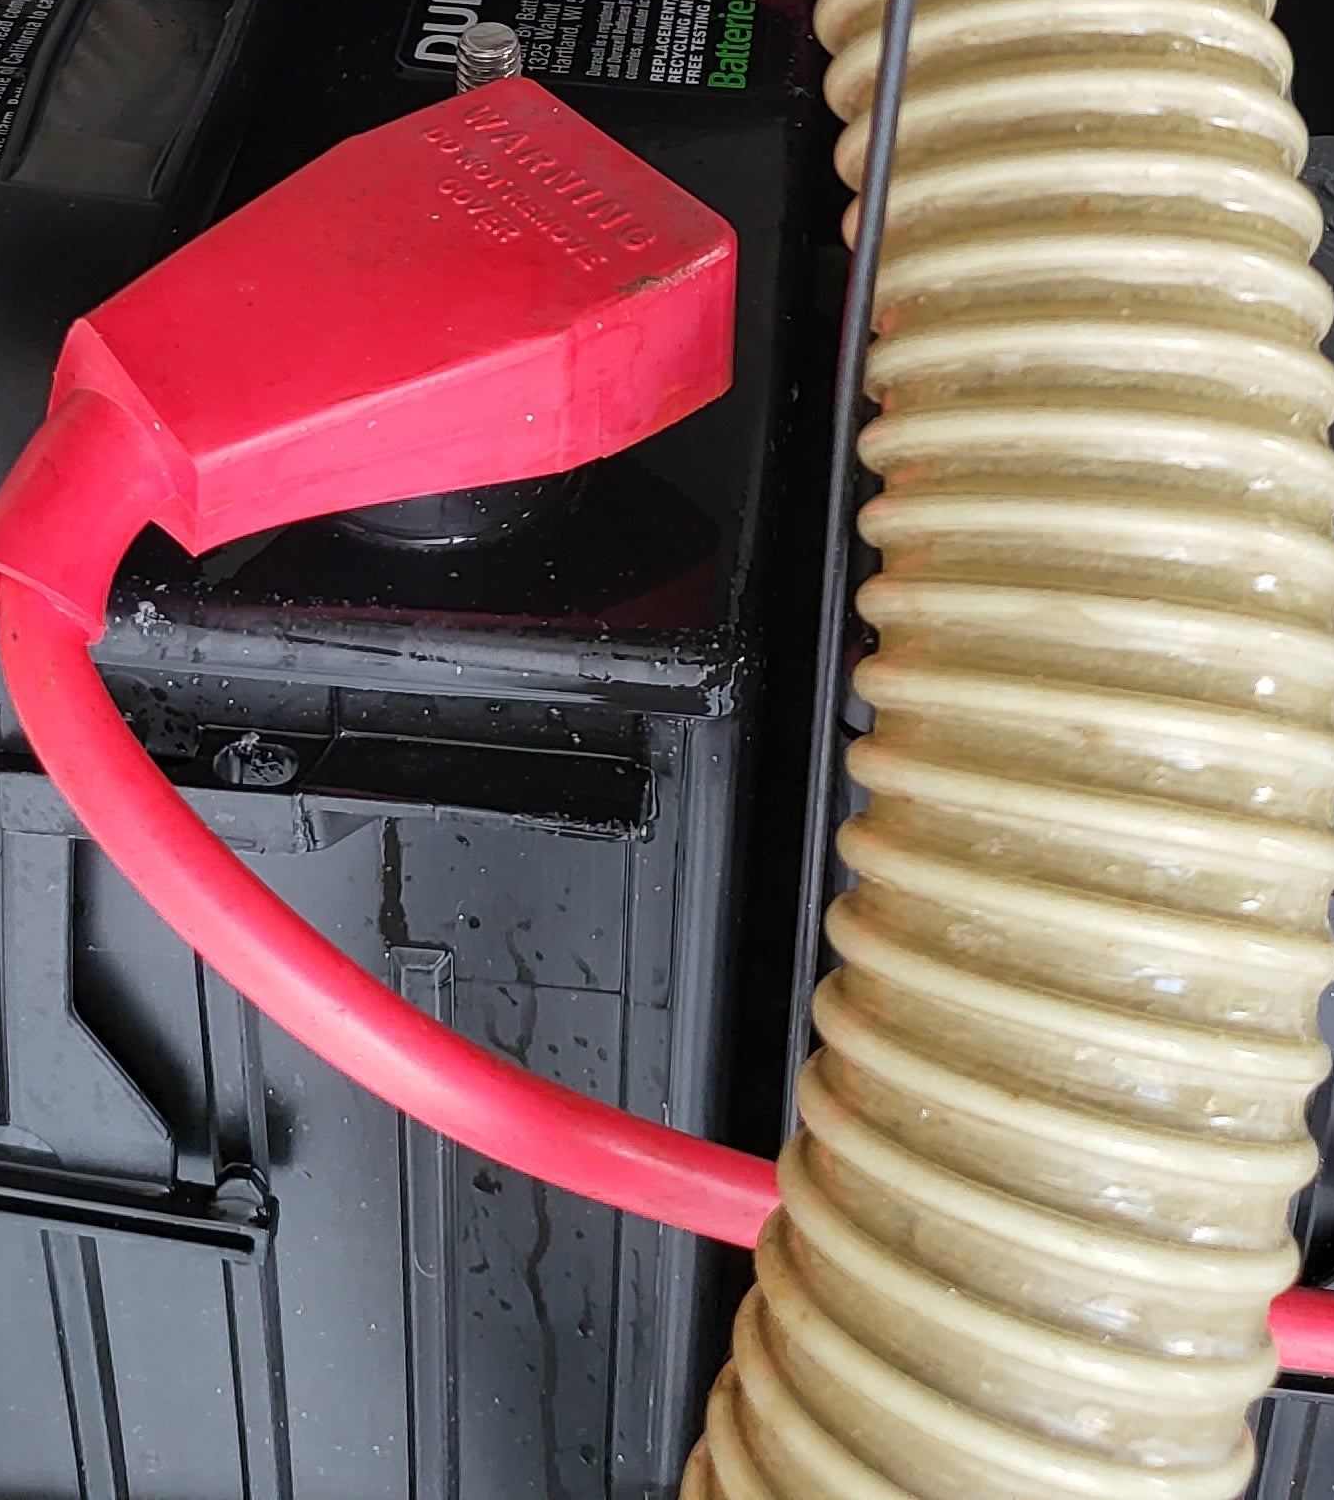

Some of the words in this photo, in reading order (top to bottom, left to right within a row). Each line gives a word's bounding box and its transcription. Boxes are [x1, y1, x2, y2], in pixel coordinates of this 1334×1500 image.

[532, 0, 562, 43] Walnut
[562, 0, 584, 23] WI
[691, 4, 711, 51] TESTING
[2, 21, 43, 65] California
[27, 10, 49, 20] to
[528, 43, 552, 71] 1325
[550, 26, 583, 74] Hartland,
[667, 17, 691, 84] RECYCLING
[685, 54, 703, 85] FREE
[423, 127, 463, 153] DO
[455, 153, 513, 189] NOT
[502, 191, 609, 271] REMOVE
[465, 105, 657, 251] WARNING
[438, 178, 521, 243] COVER
